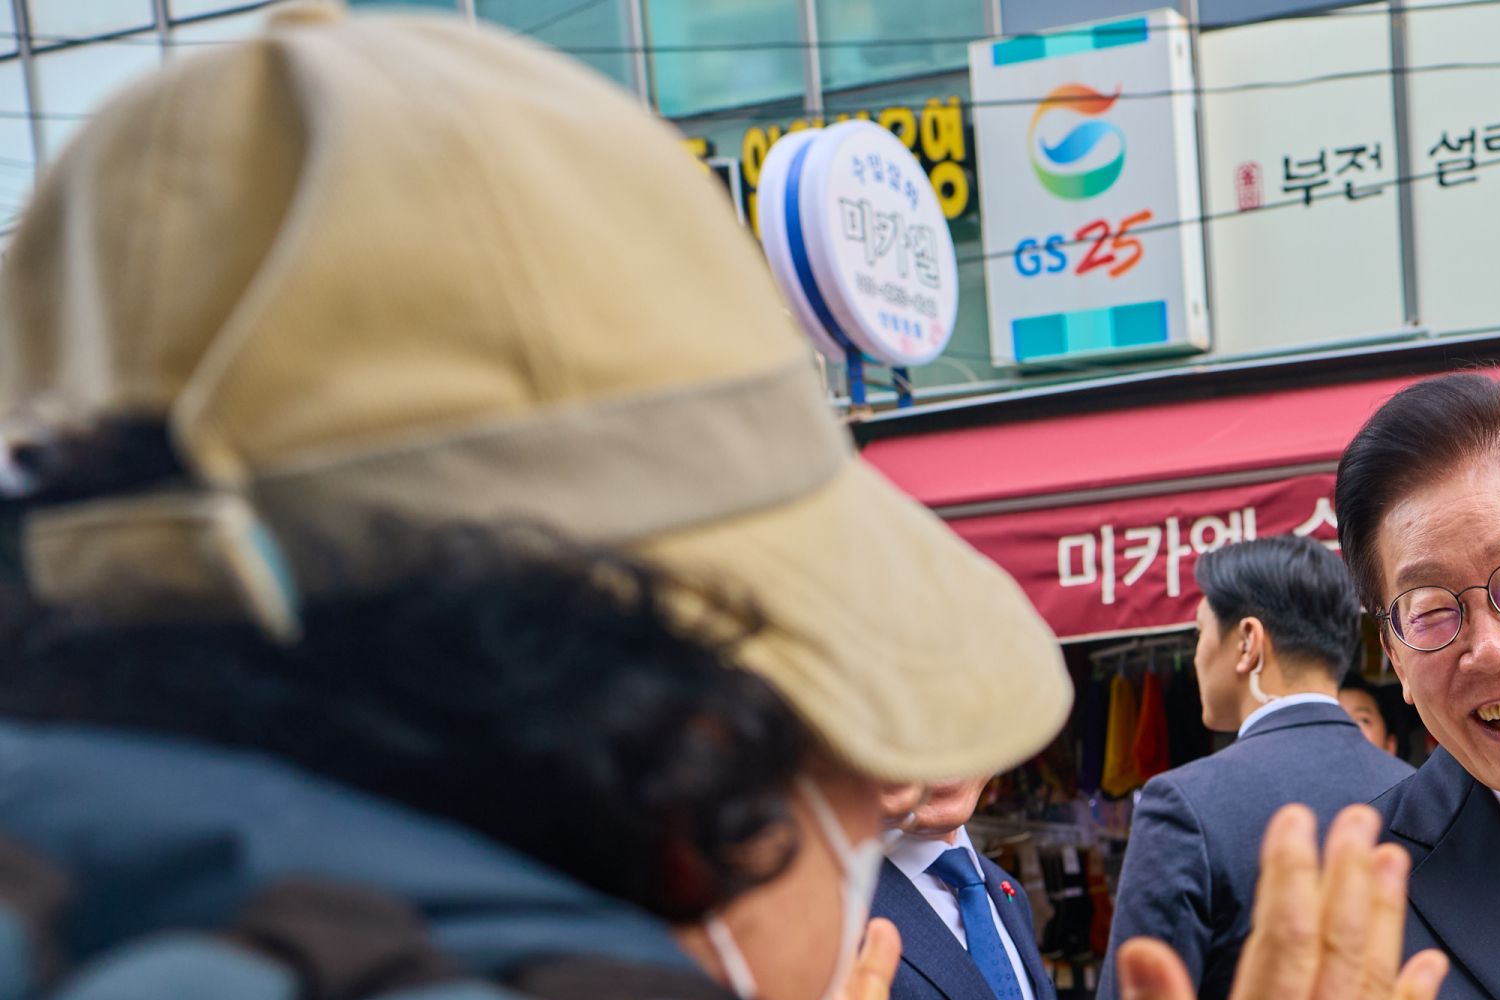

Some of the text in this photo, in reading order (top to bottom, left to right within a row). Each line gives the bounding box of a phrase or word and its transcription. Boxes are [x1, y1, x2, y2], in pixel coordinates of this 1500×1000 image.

[1281, 144, 1384, 206] 부전
[838, 196, 941, 290] 미카엘
[1014, 208, 1153, 279] GS25
